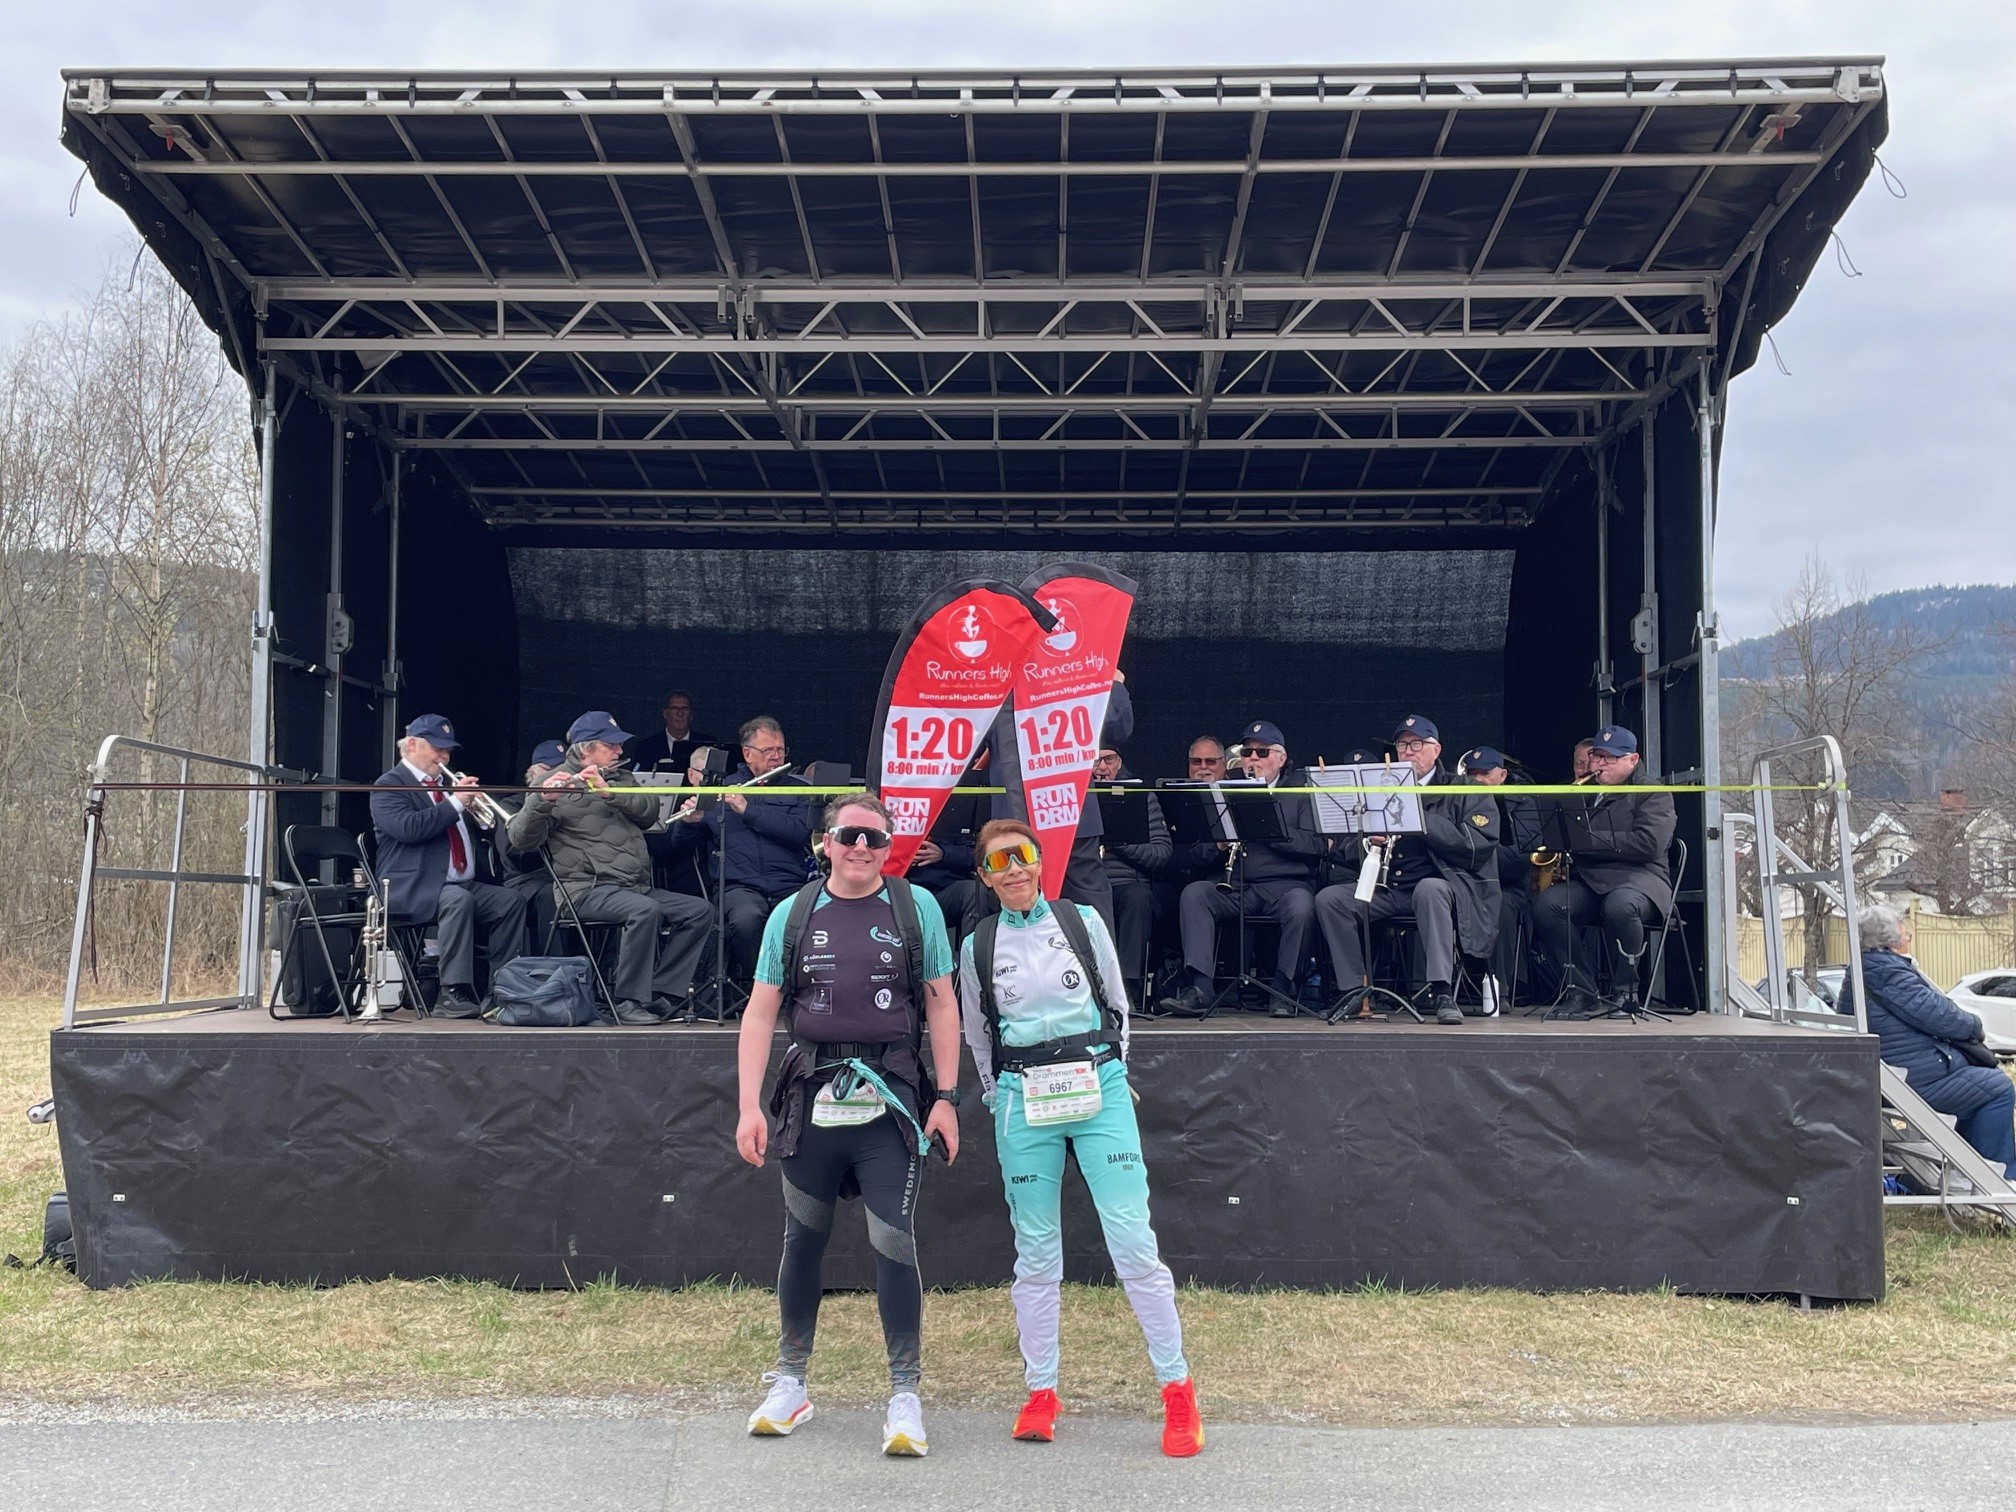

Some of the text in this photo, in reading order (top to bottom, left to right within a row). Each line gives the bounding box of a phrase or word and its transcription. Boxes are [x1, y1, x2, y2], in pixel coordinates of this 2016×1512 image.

[926, 661, 1011, 682] Runners High
[1023, 661, 1083, 682] Runners
[1085, 648, 1109, 671] High
[891, 716, 974, 760] 1:20
[1020, 705, 1094, 755] 1:20
[886, 761, 913, 775] 8:00
[916, 762, 939, 775] min
[1028, 754, 1052, 771] 8:00
[1054, 752, 1075, 766] min
[1031, 786, 1077, 808] RUN
[1034, 805, 1078, 831] DRM
[1049, 1081, 1073, 1094] 6967
